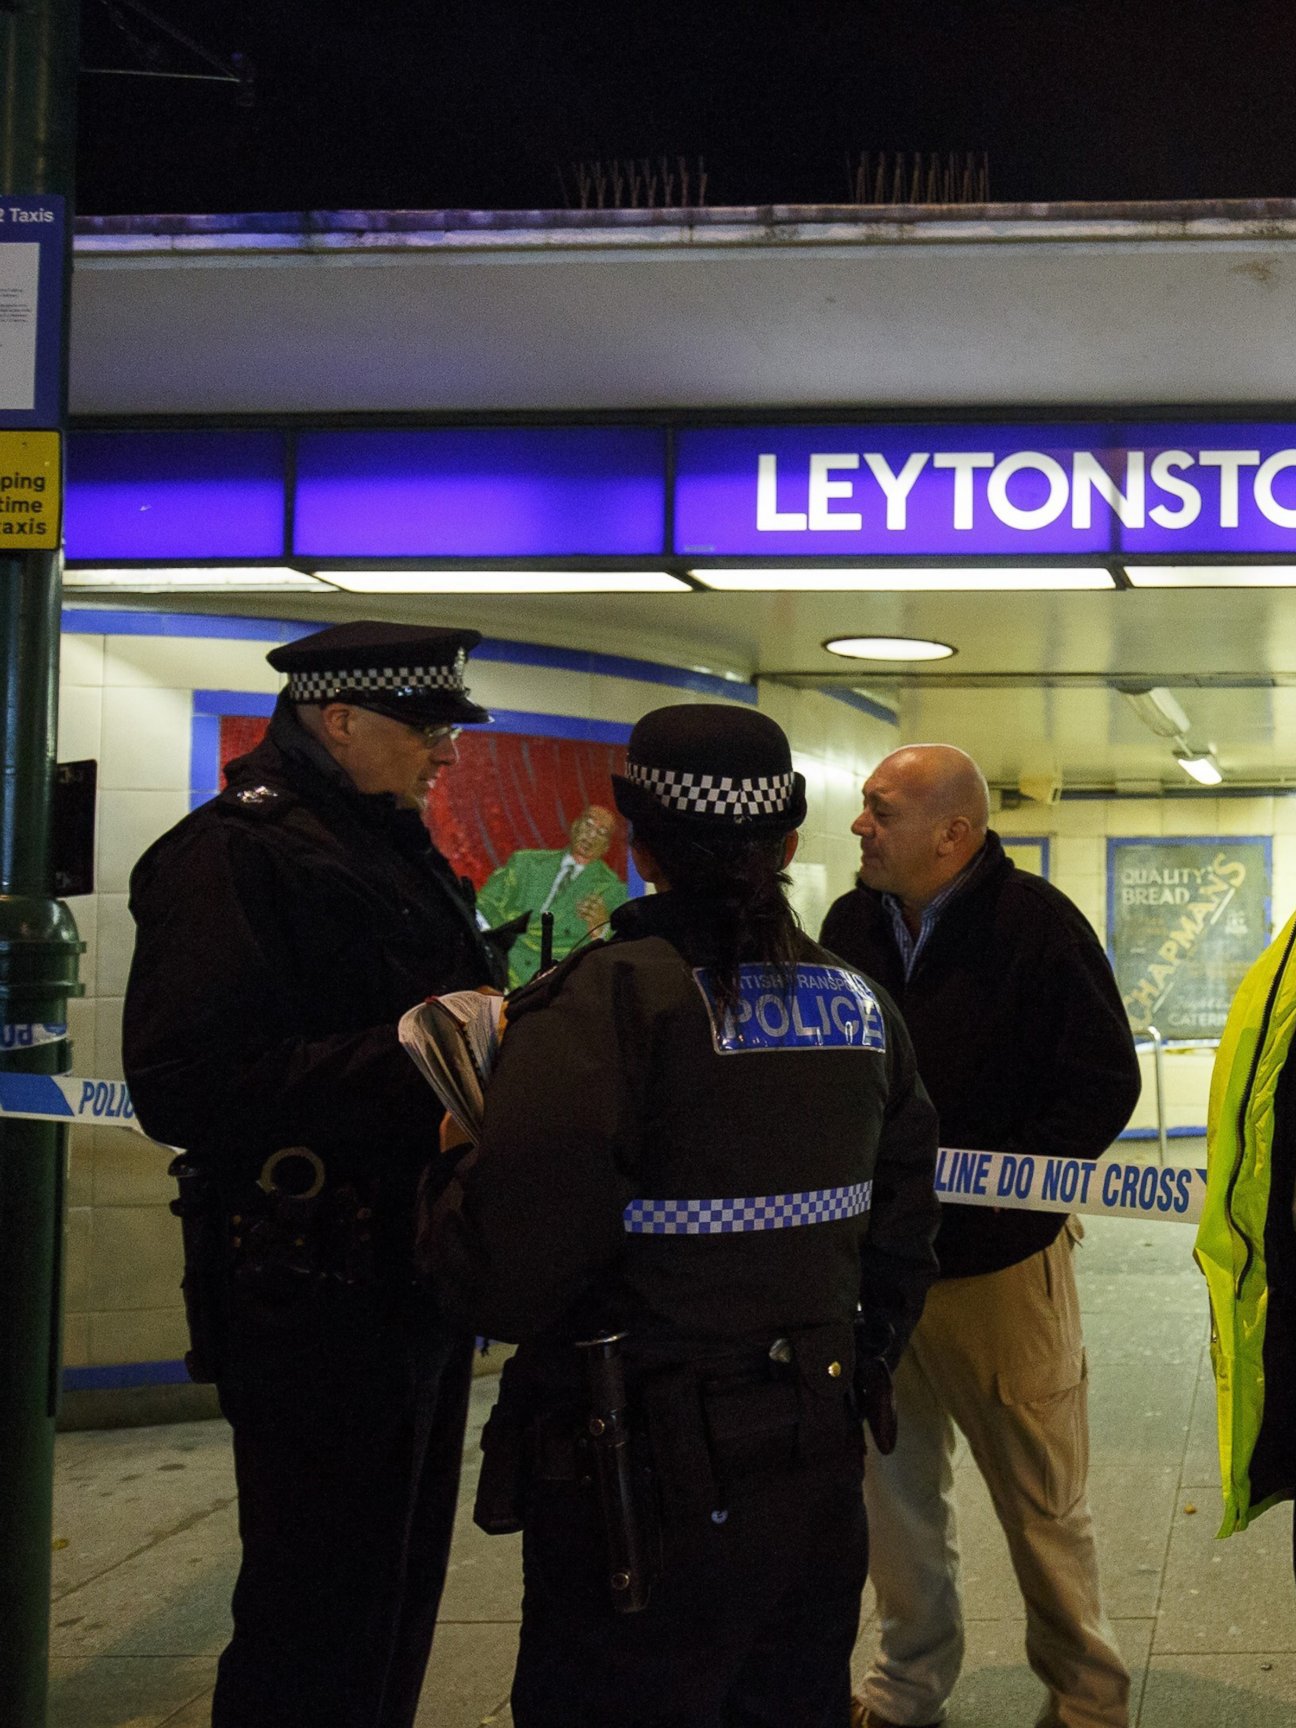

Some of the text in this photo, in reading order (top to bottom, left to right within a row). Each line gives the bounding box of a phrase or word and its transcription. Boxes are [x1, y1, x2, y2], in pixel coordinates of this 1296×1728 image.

[9, 207, 55, 223] Taxis
[0, 519, 48, 535] axis
[1120, 886, 1191, 906] BREAD
[723, 994, 882, 1046] POLICE
[934, 1150, 1192, 1214] LINE DO NOT CROSS
